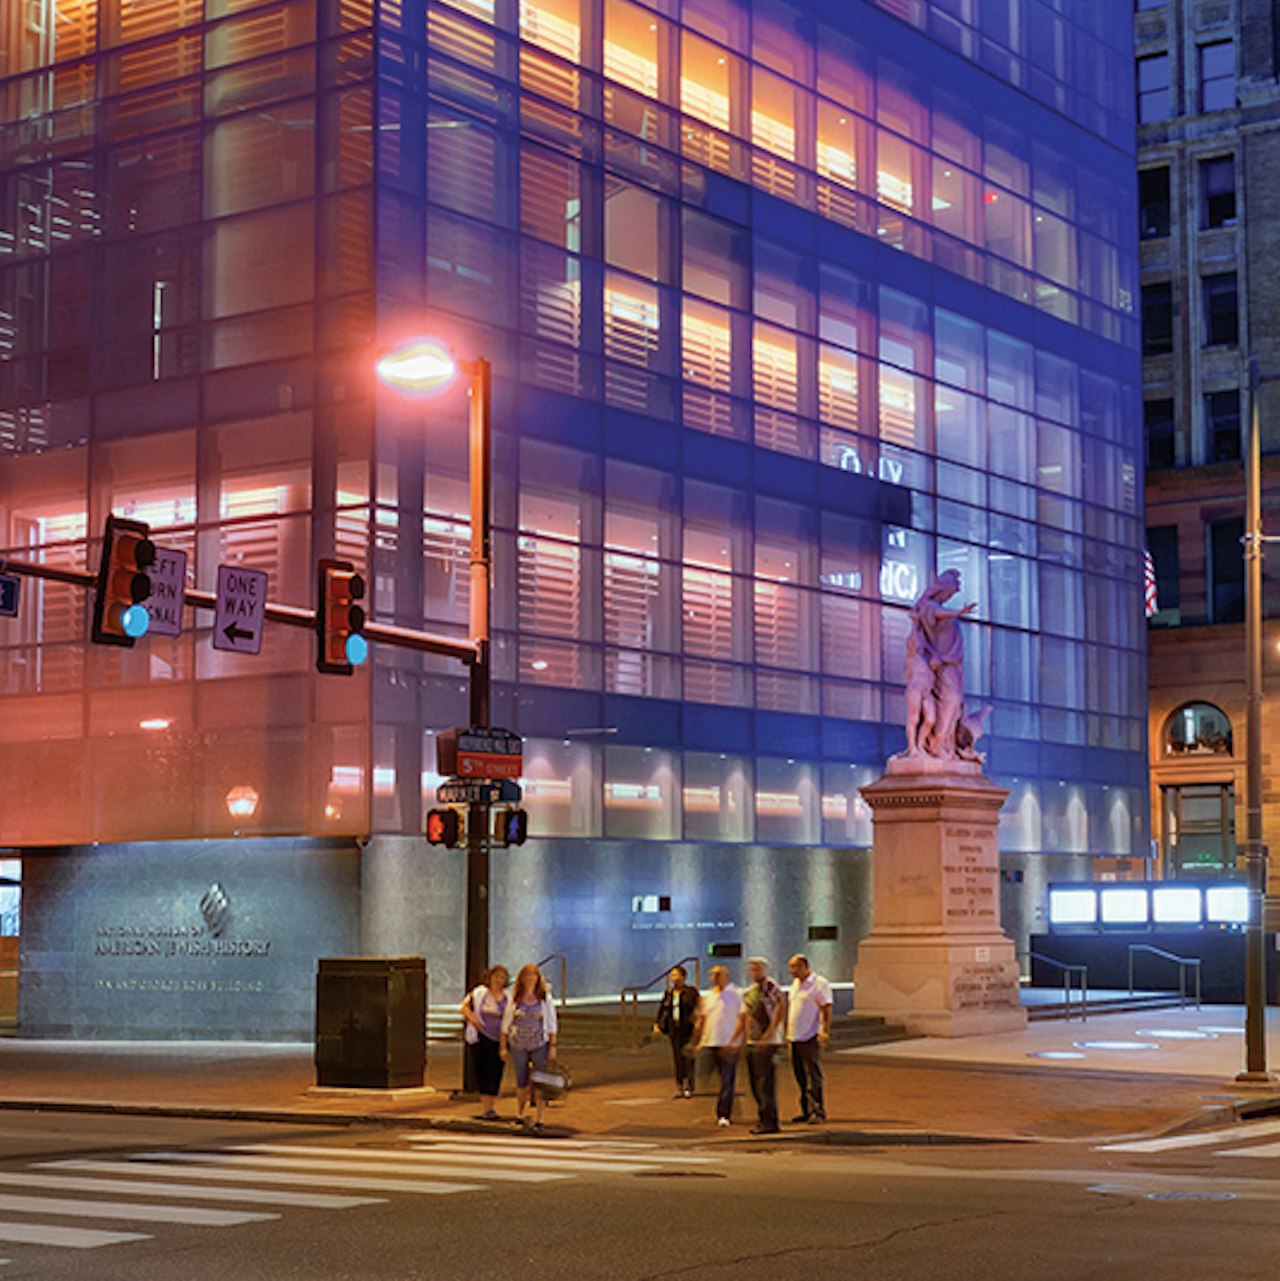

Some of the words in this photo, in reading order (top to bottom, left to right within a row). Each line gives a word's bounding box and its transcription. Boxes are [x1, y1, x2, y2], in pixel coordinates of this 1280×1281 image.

[151, 558, 177, 576] EFT
[227, 574, 257, 596] ONE
[225, 598, 257, 618] WAY
[214, 939, 272, 958] HISTORY
